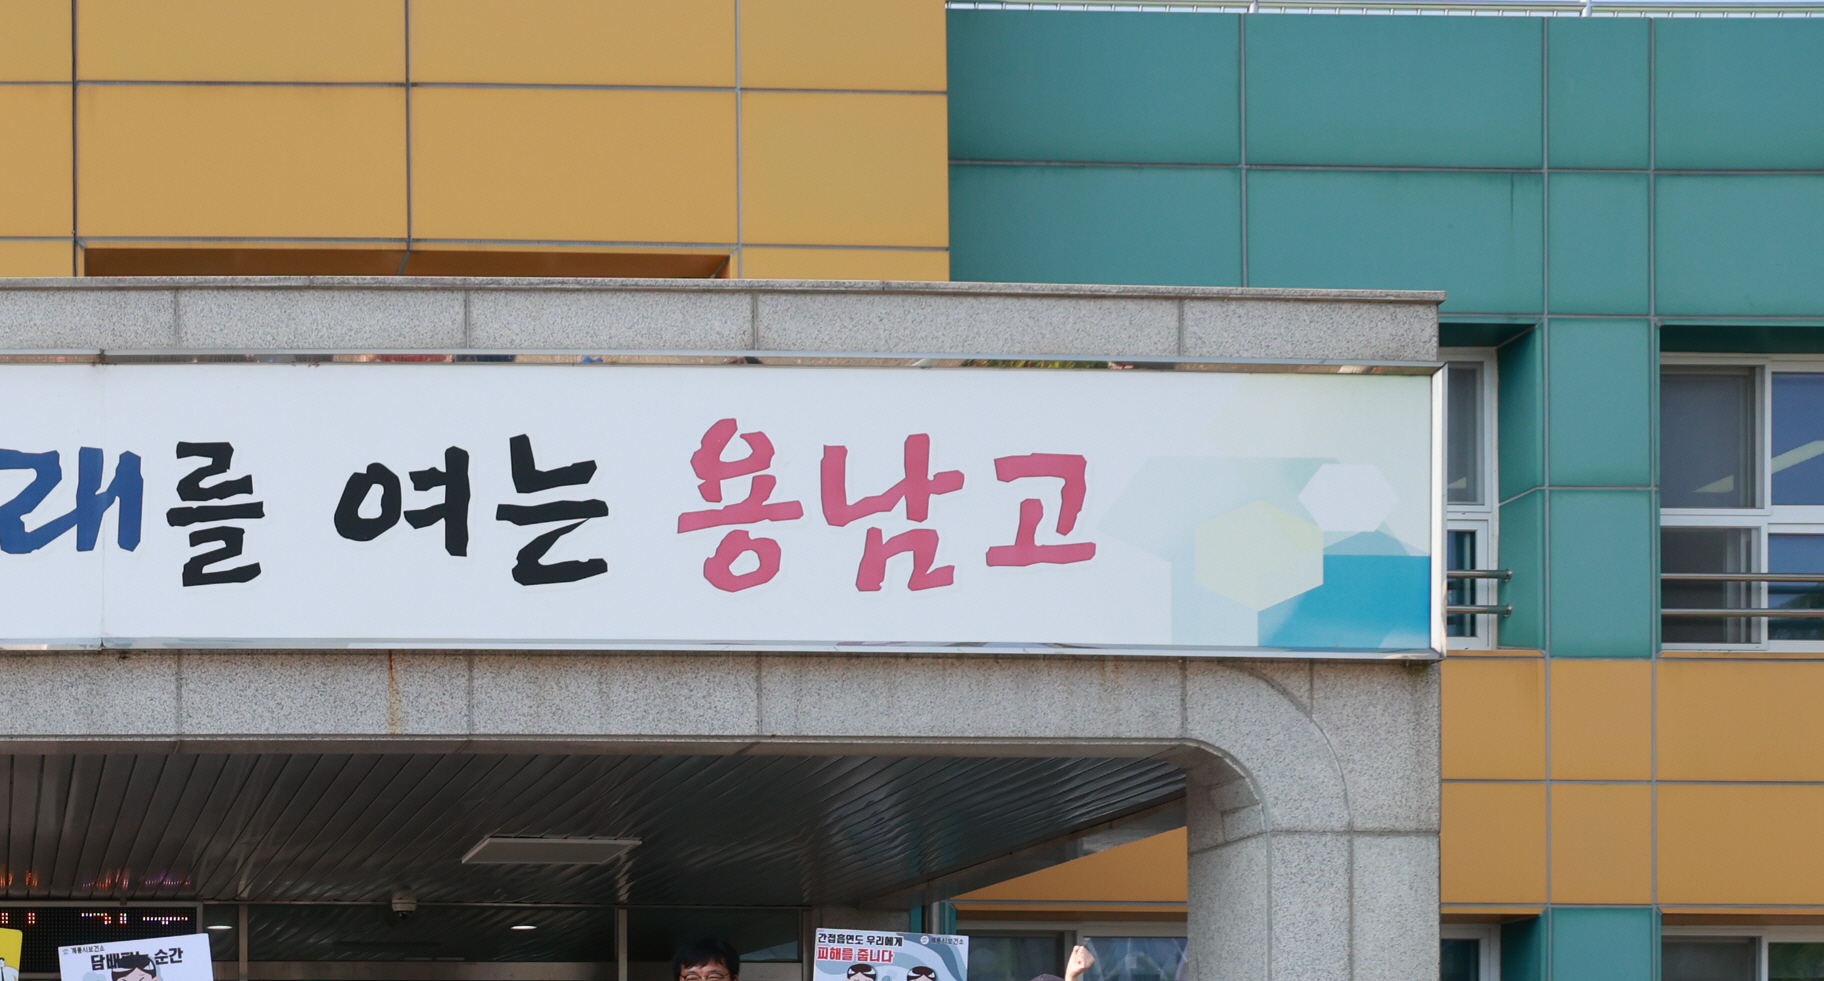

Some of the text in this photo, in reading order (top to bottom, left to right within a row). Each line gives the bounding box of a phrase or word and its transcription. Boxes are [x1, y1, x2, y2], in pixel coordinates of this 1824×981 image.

[334, 433, 609, 587] 여는
[677, 418, 1097, 592] 용남고
[818, 933, 903, 946] 간접흡연도 우리에게
[154, 947, 183, 965] 순간
[818, 947, 894, 962] 피해를 줍니다
